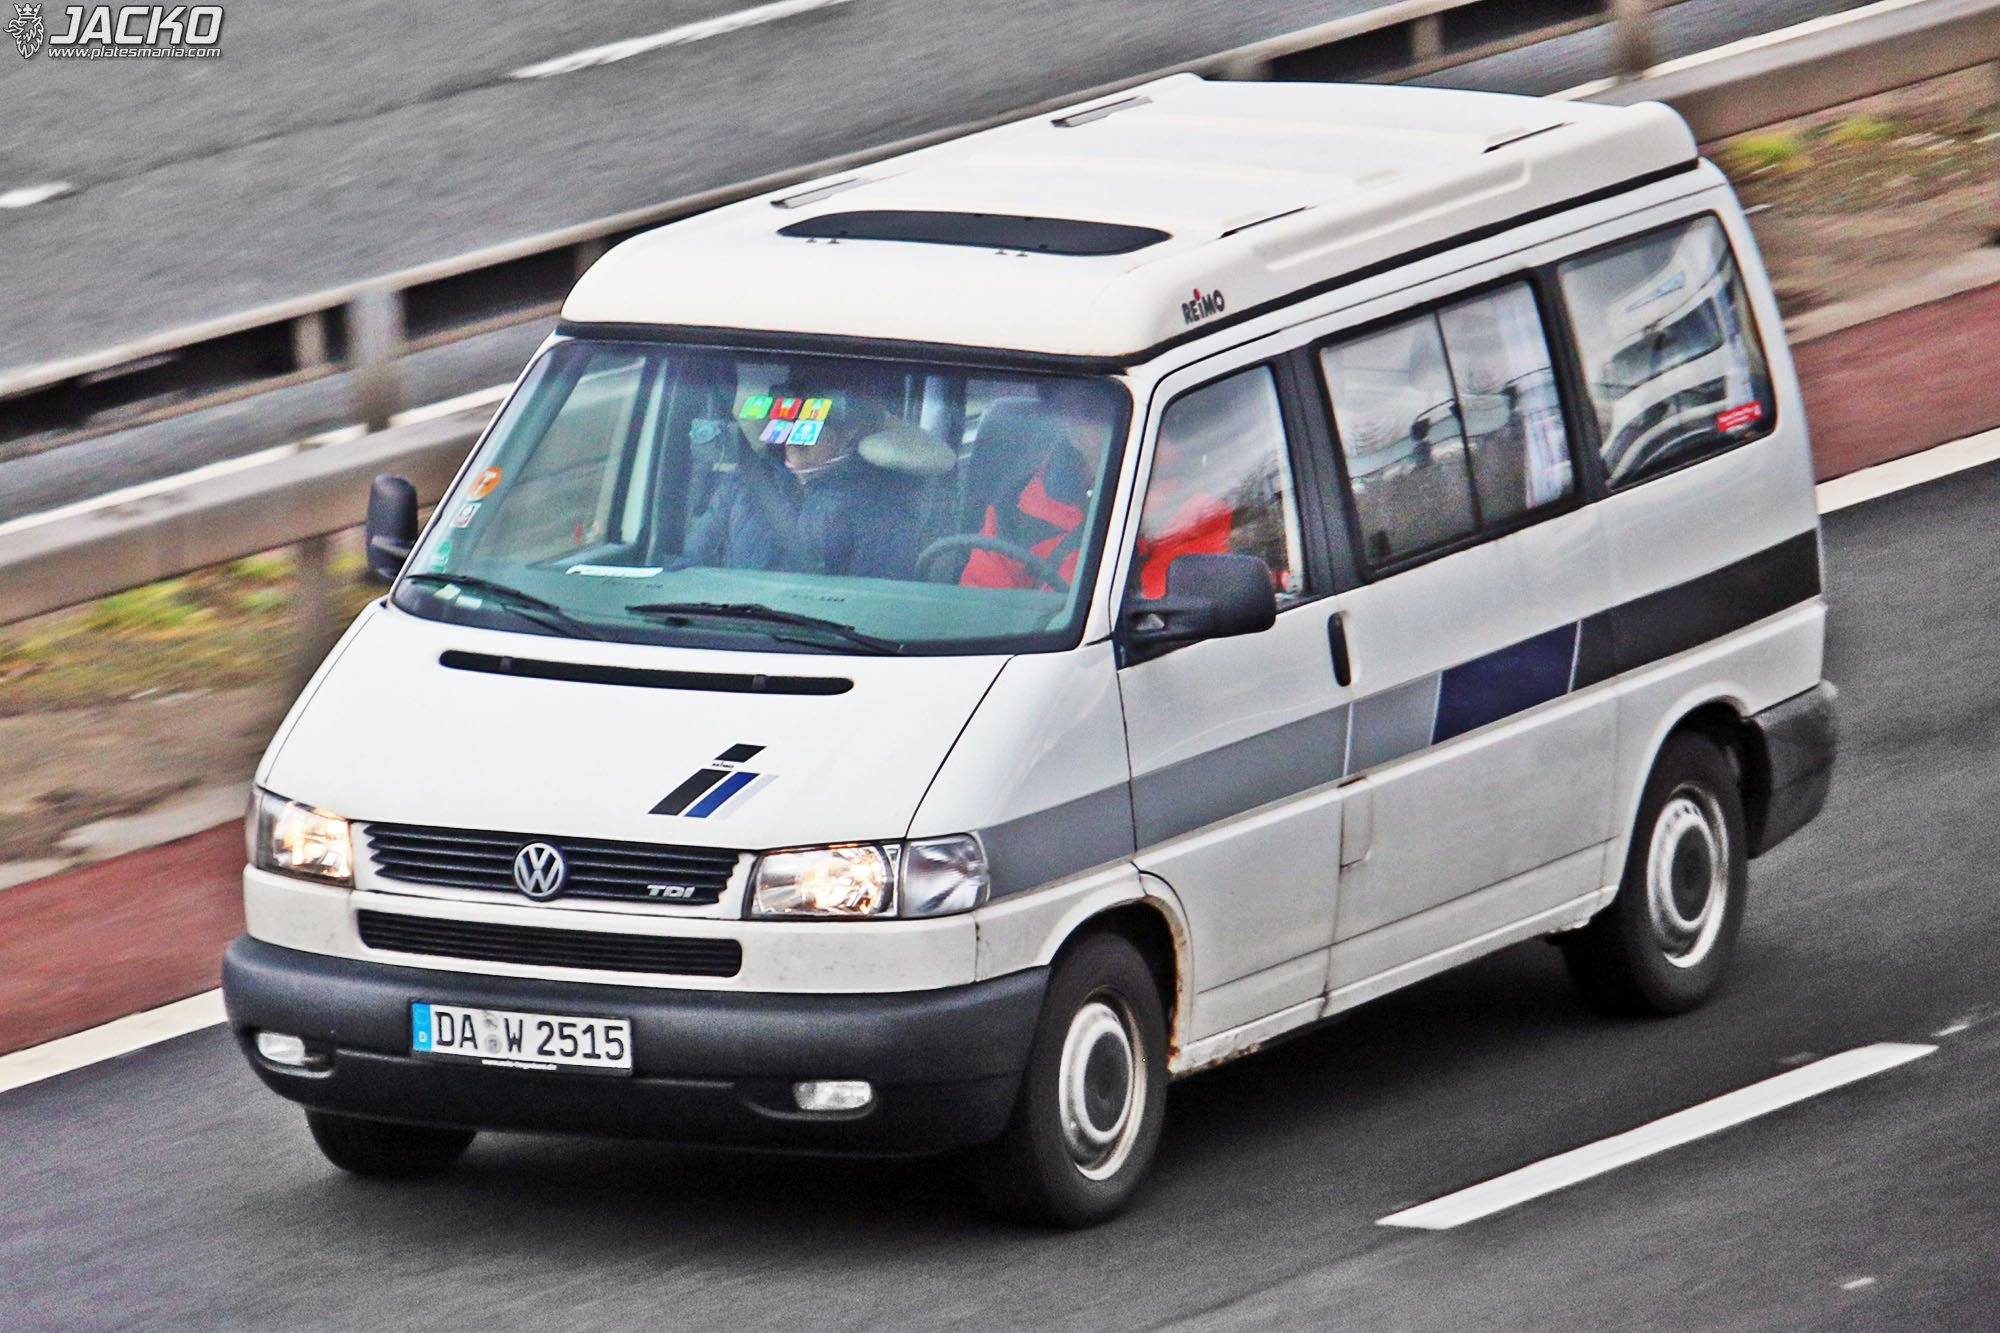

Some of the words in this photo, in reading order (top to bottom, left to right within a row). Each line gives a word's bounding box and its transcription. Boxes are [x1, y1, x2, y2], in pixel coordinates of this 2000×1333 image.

[514, 842, 564, 898] VW
[646, 884, 695, 898] TDI
[435, 1011, 478, 1050] DA
[504, 1018, 523, 1053] W
[537, 1021, 625, 1061] 2515
